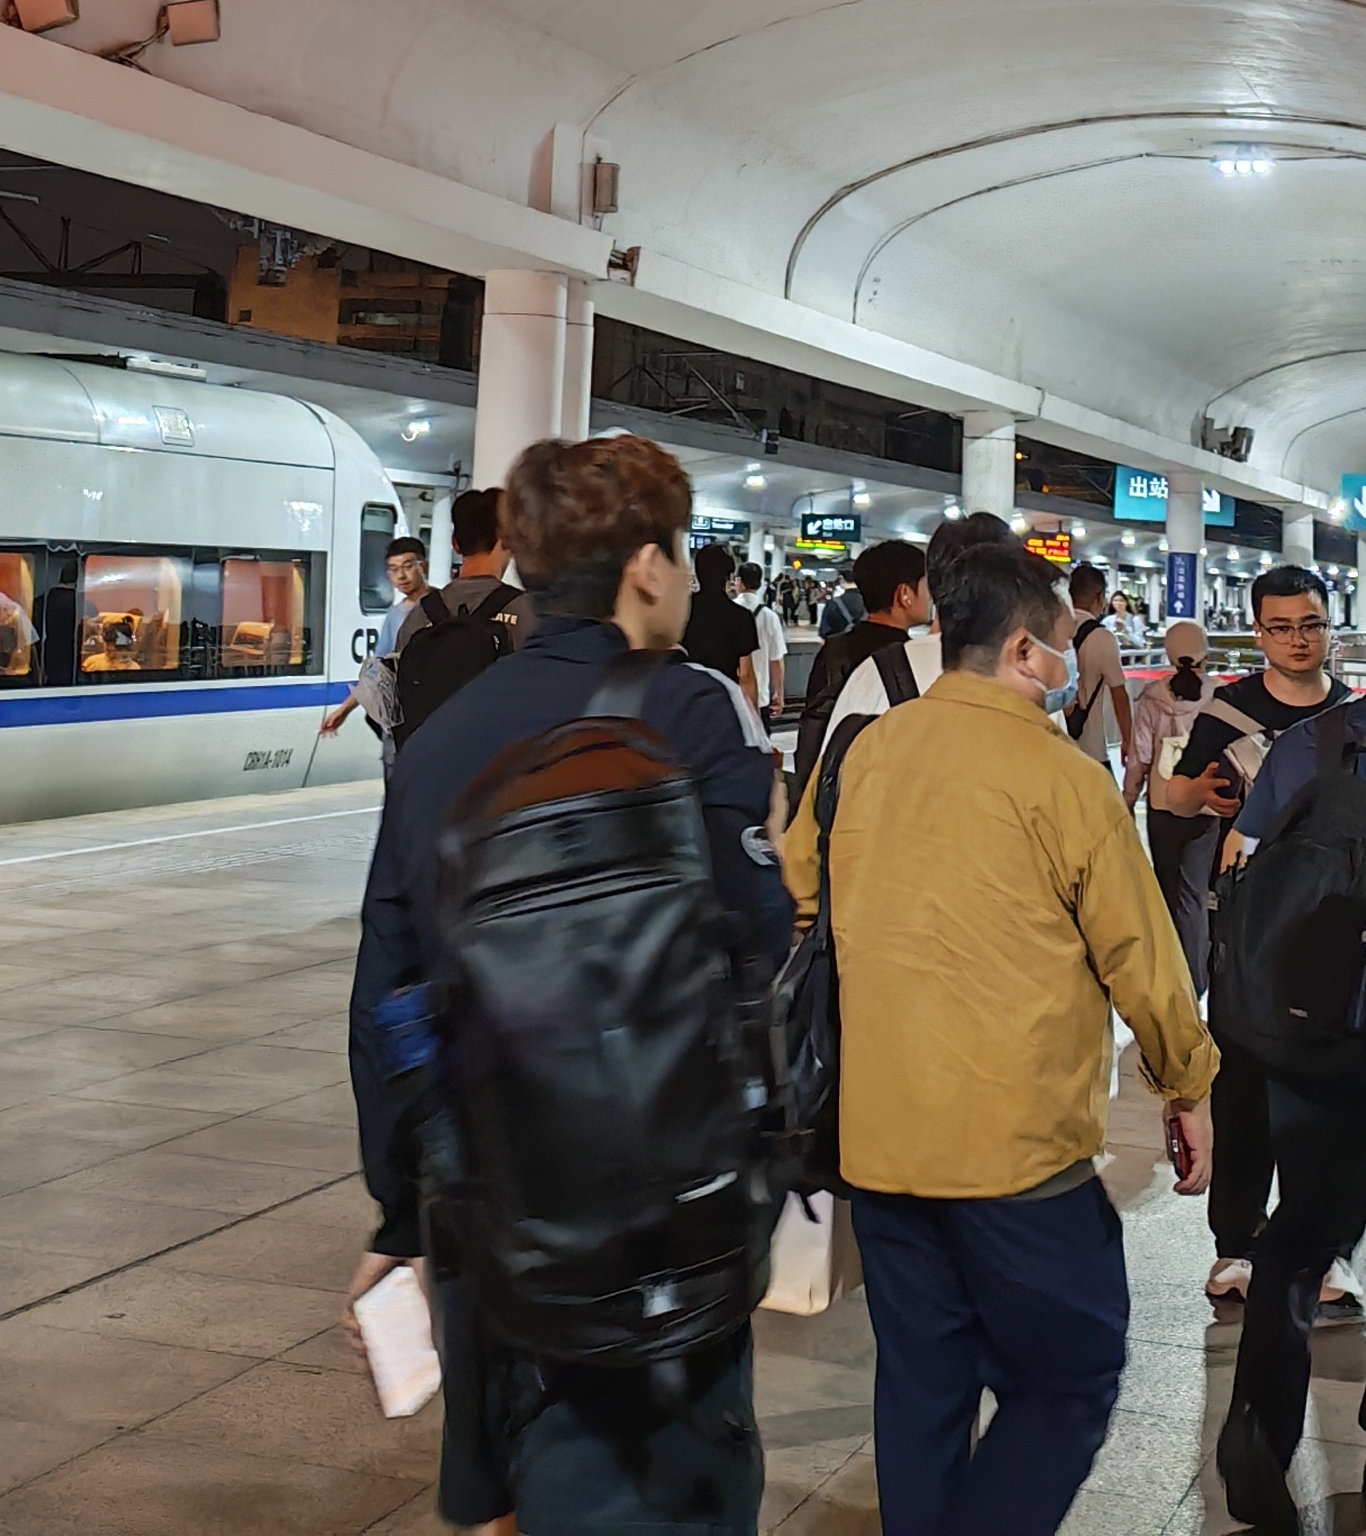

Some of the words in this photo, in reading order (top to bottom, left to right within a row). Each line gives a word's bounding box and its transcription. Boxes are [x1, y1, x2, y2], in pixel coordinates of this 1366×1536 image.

[1128, 475, 1169, 499] 出站
[490, 612, 518, 625] ATE
[351, 628, 379, 664] CR
